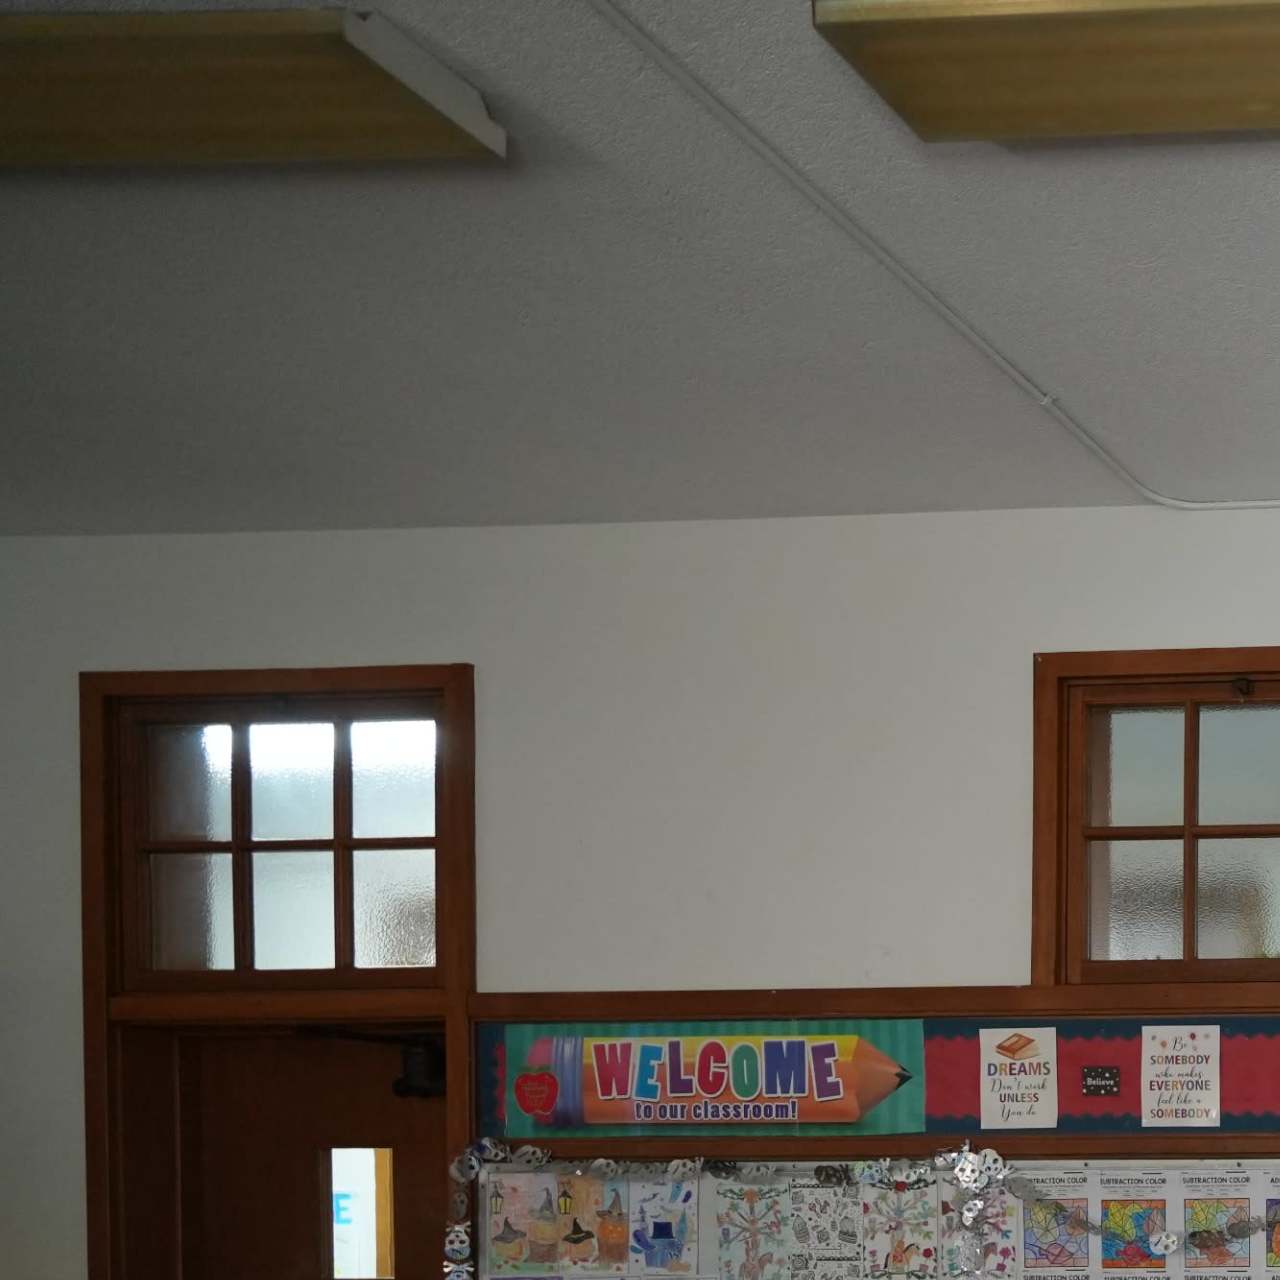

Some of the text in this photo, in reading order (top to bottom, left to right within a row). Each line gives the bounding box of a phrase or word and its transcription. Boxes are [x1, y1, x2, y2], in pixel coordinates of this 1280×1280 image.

[1172, 1036, 1188, 1051] Be
[1150, 1055, 1211, 1065] SOMEBODY
[592, 1039, 843, 1101] WELCOME
[987, 1062, 1051, 1076] DREAMS
[1177, 1069, 1203, 1080] makes
[990, 1077, 1048, 1092] Don't work
[1086, 1077, 1115, 1086] Believe
[1149, 1080, 1211, 1091] EVERYONE
[999, 1092, 1039, 1103] UNLESS
[1157, 1093, 1174, 1108] feel
[1176, 1092, 1192, 1105] like
[635, 1100, 797, 1119] to our classroom!
[1001, 1104, 1037, 1121] You do
[1150, 1108, 1211, 1119] SOMEBODY
[1228, 1176, 1250, 1184] COLOR
